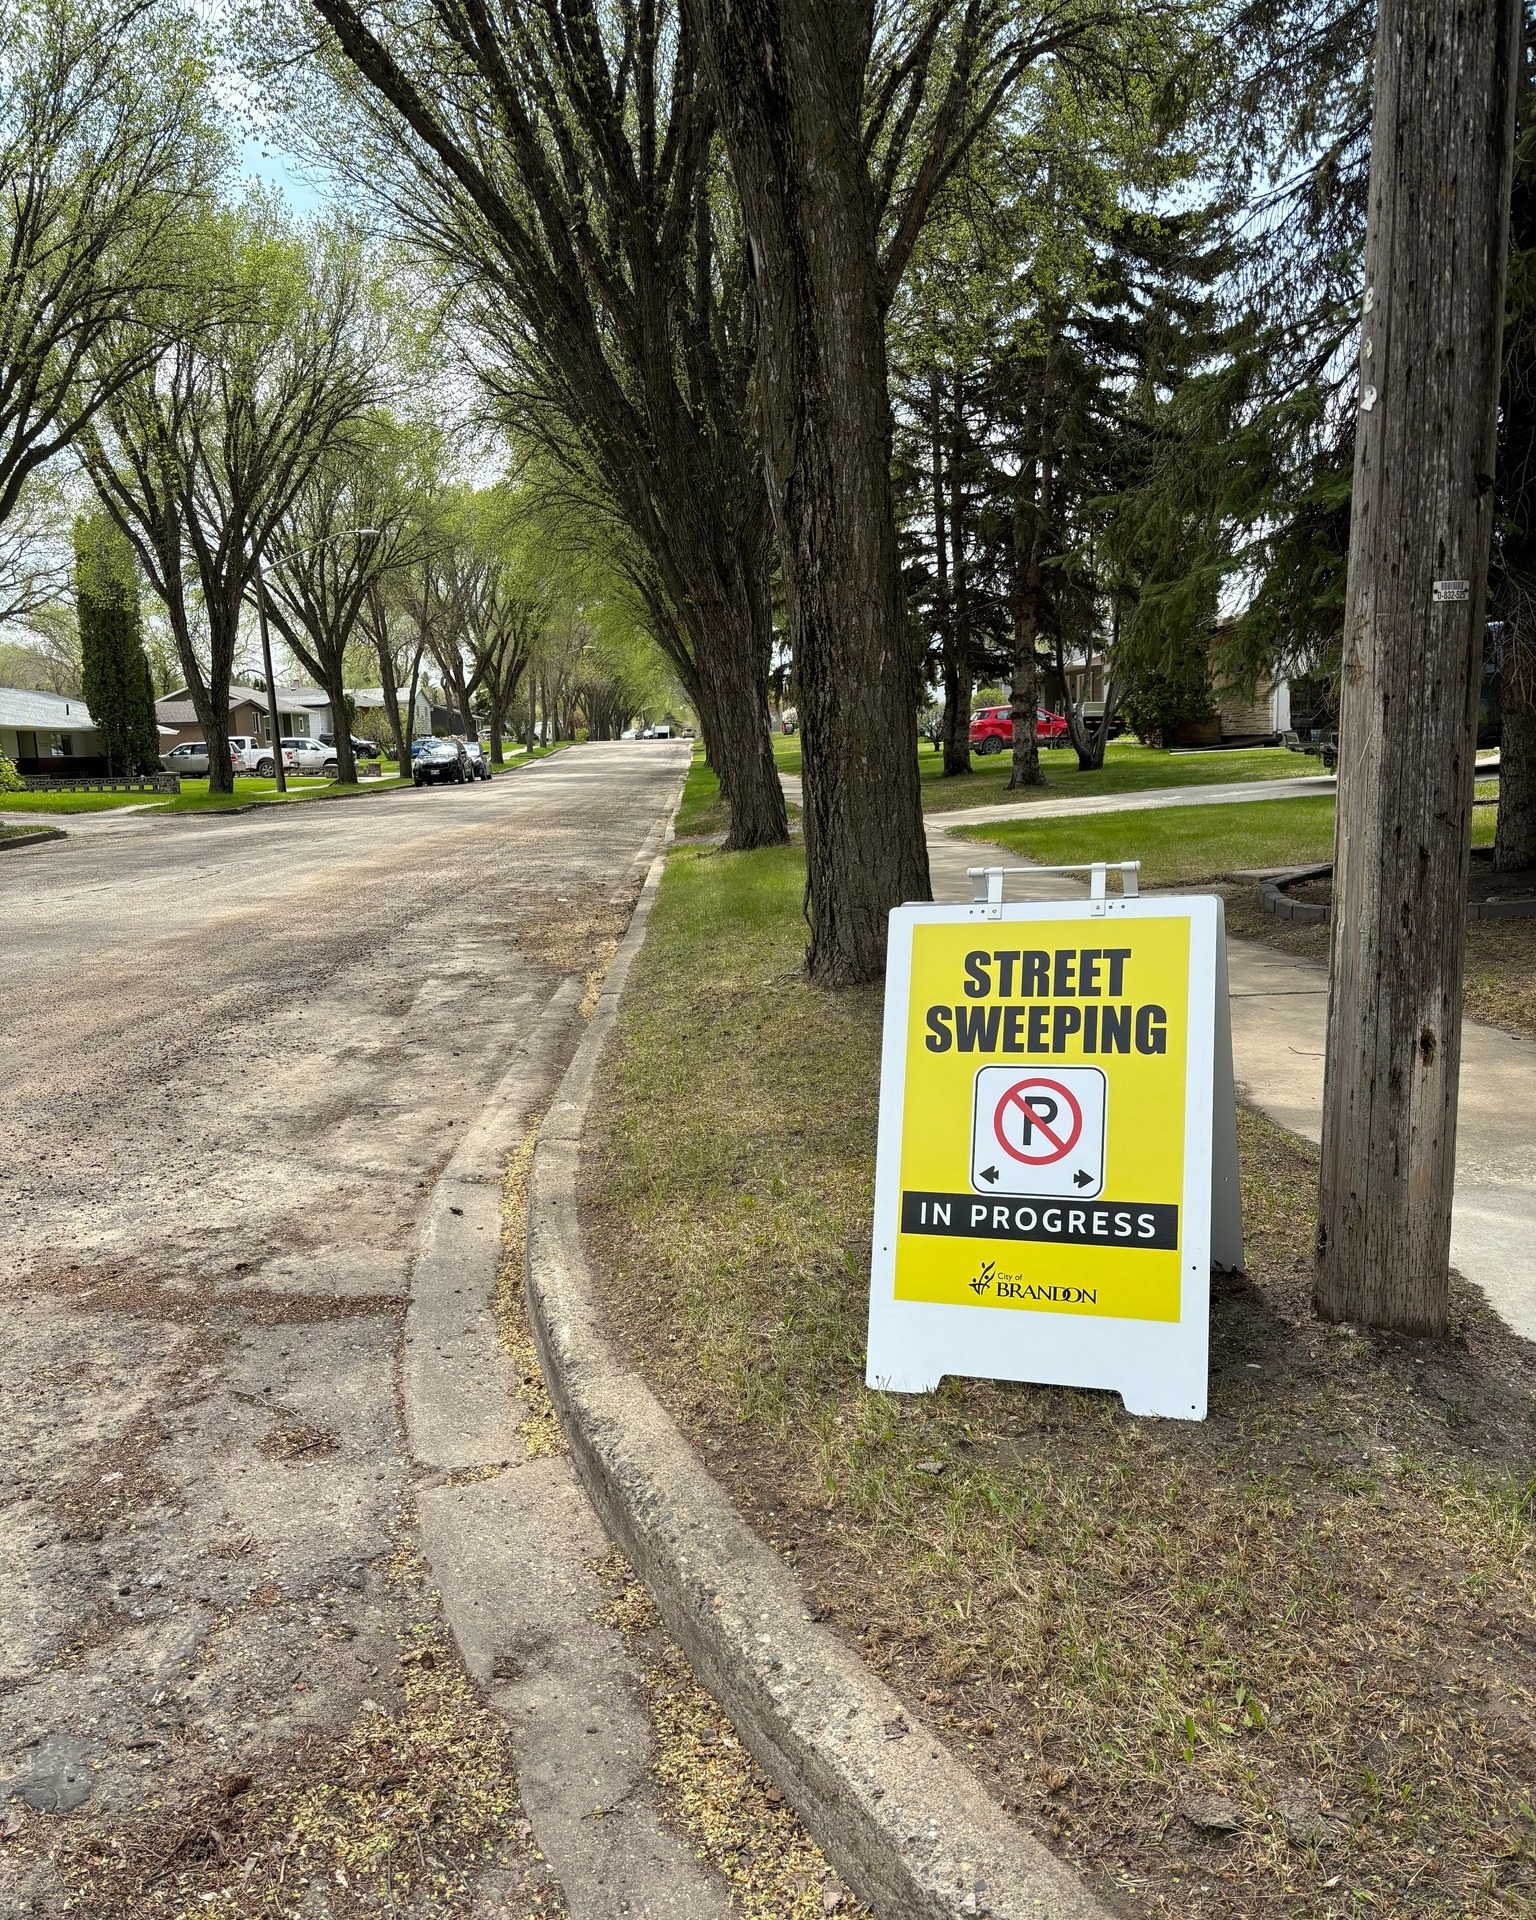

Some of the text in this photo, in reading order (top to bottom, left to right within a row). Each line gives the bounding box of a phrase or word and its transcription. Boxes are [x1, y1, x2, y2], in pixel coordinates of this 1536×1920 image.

[963, 948, 1131, 999] STREET
[925, 1004, 1168, 1056] SWEEPING
[1022, 1096, 1058, 1146] P
[920, 1202, 1156, 1238] IN PROGRESS
[996, 1282, 1098, 1304] BRANDON
[997, 1272, 1023, 1282] City of
